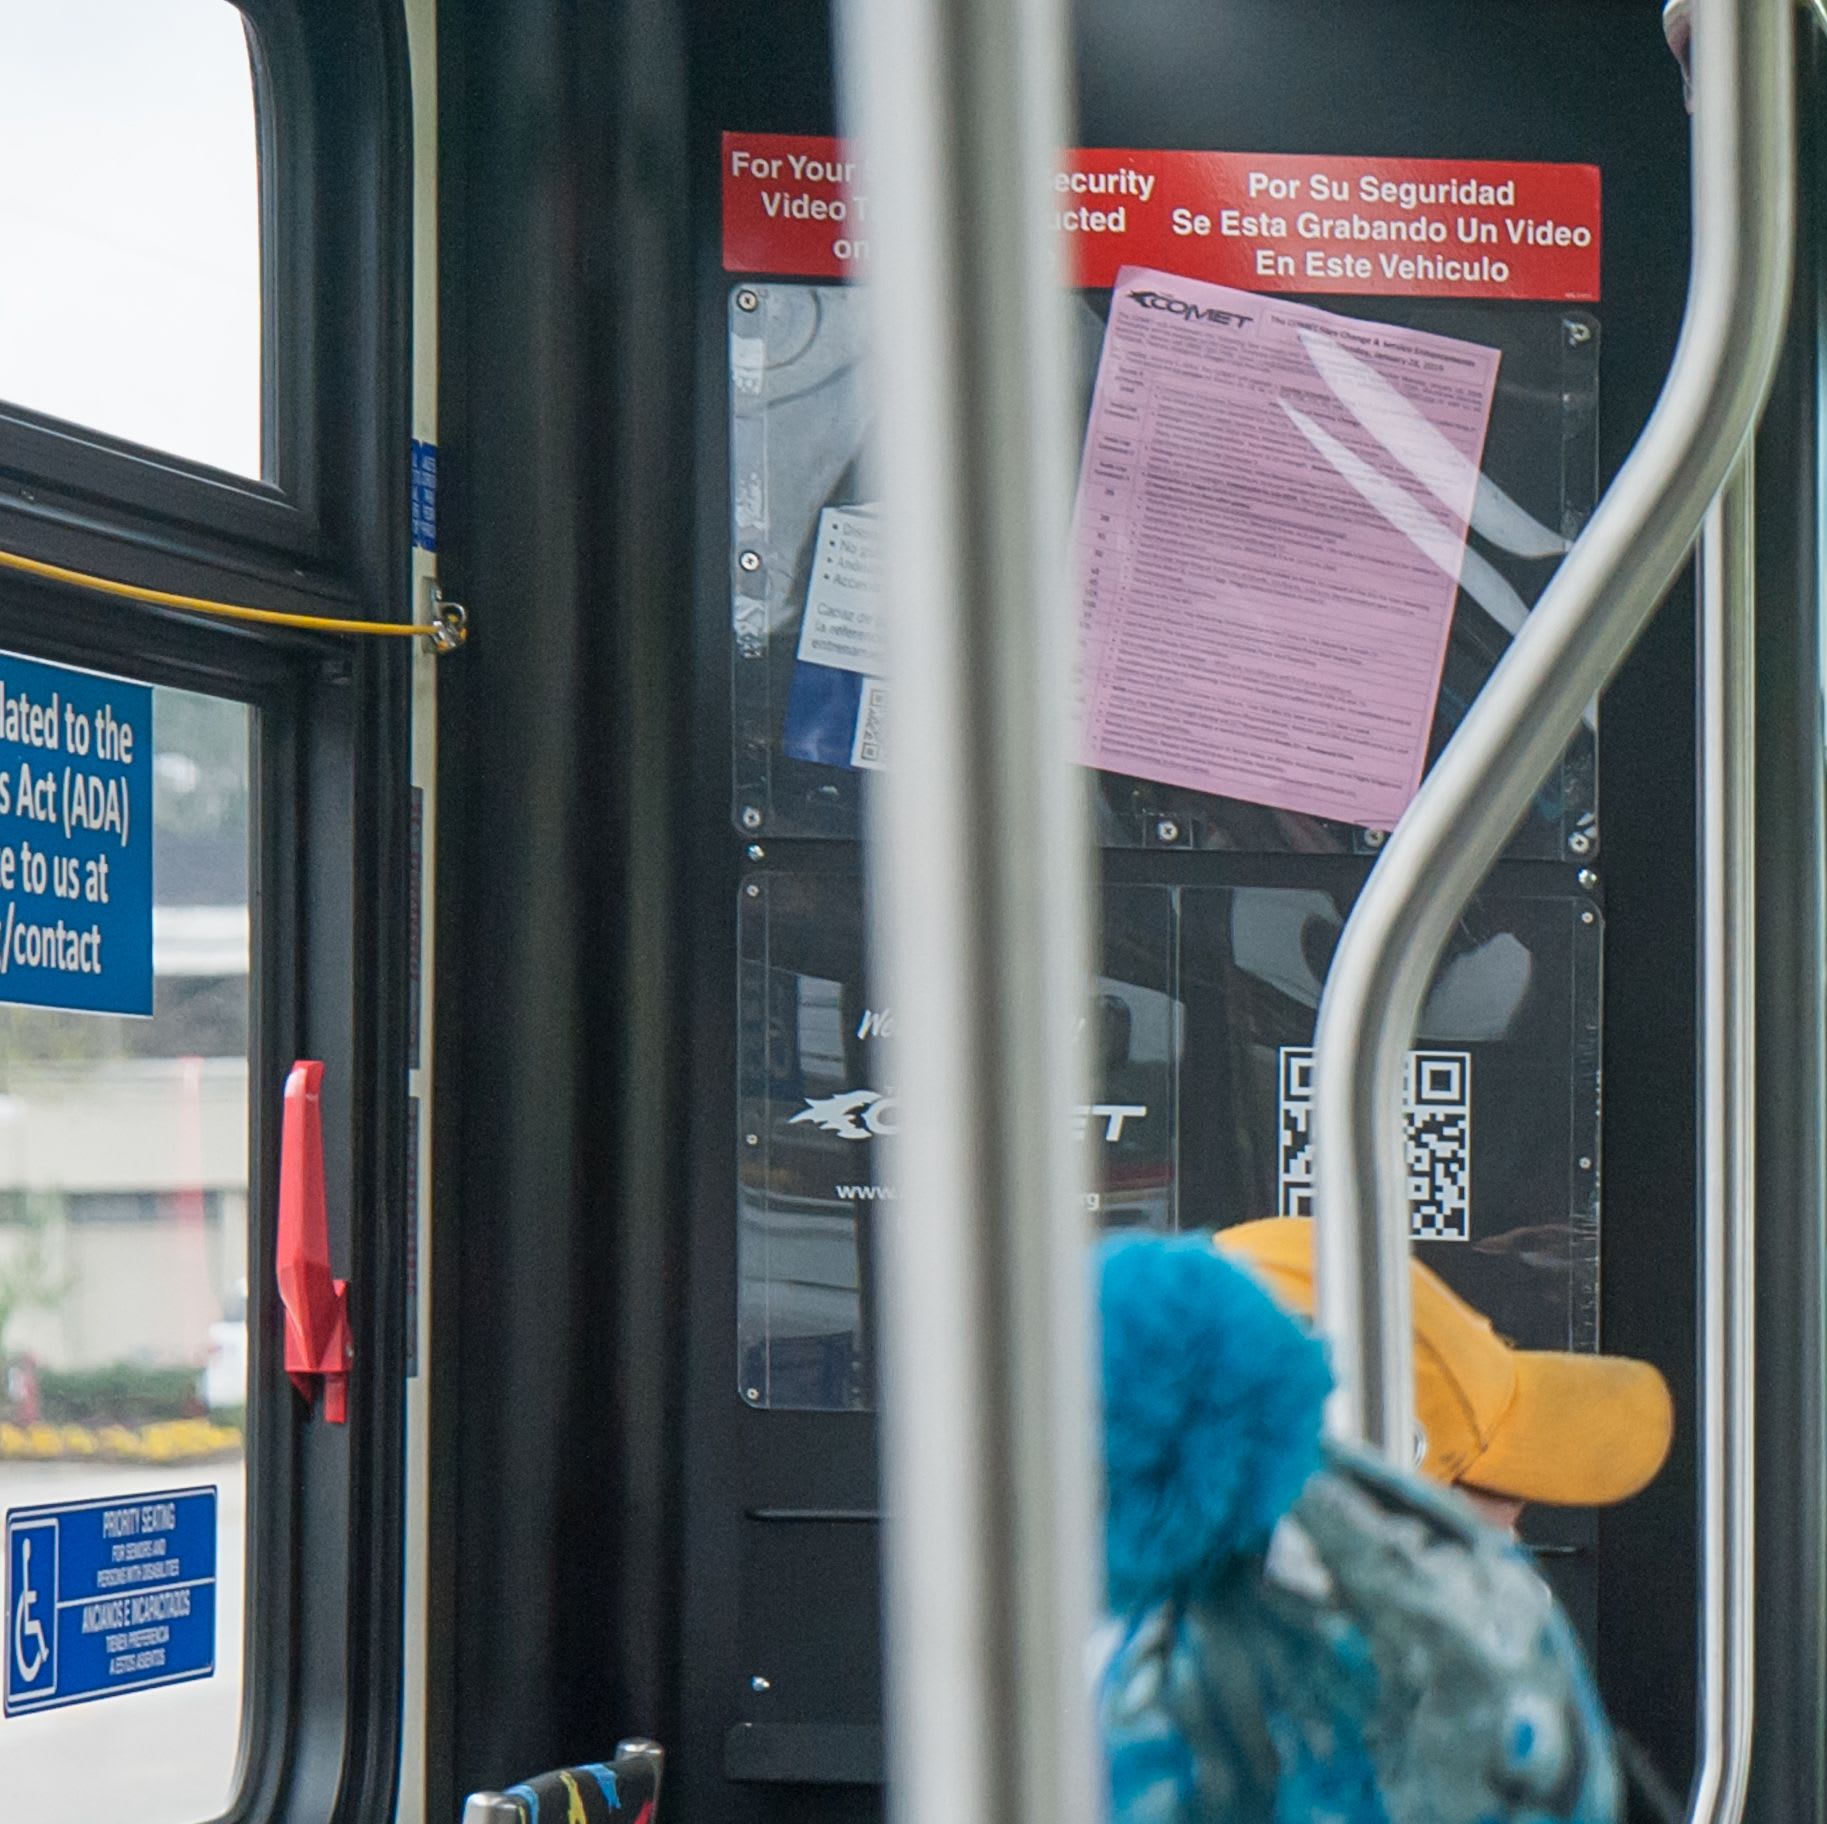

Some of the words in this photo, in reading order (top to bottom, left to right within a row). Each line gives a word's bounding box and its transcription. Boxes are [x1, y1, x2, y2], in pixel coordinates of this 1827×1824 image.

[731, 151, 783, 179] For
[786, 152, 856, 182] Your
[1053, 168, 1155, 201] ecurity
[1247, 172, 1301, 200] Por
[1308, 173, 1350, 201] Su
[1359, 175, 1516, 210] Seguridad
[760, 190, 847, 222] Video
[1172, 208, 1212, 236] Se
[1220, 210, 1288, 238] Esta
[1295, 211, 1448, 242] Grabando
[1456, 216, 1499, 244] Un
[1505, 218, 1592, 248] Video
[1255, 250, 1296, 277] En
[1305, 250, 1373, 279] Este
[1378, 253, 1511, 283] Vehiculo
[1146, 297, 1254, 329] COMET
[64, 702, 90, 756] to
[95, 703, 133, 764] the
[16, 762, 57, 823] Act
[63, 766, 129, 847] (ADA)
[20, 840, 48, 895] to
[53, 855, 80, 900] us
[85, 853, 109, 904] at
